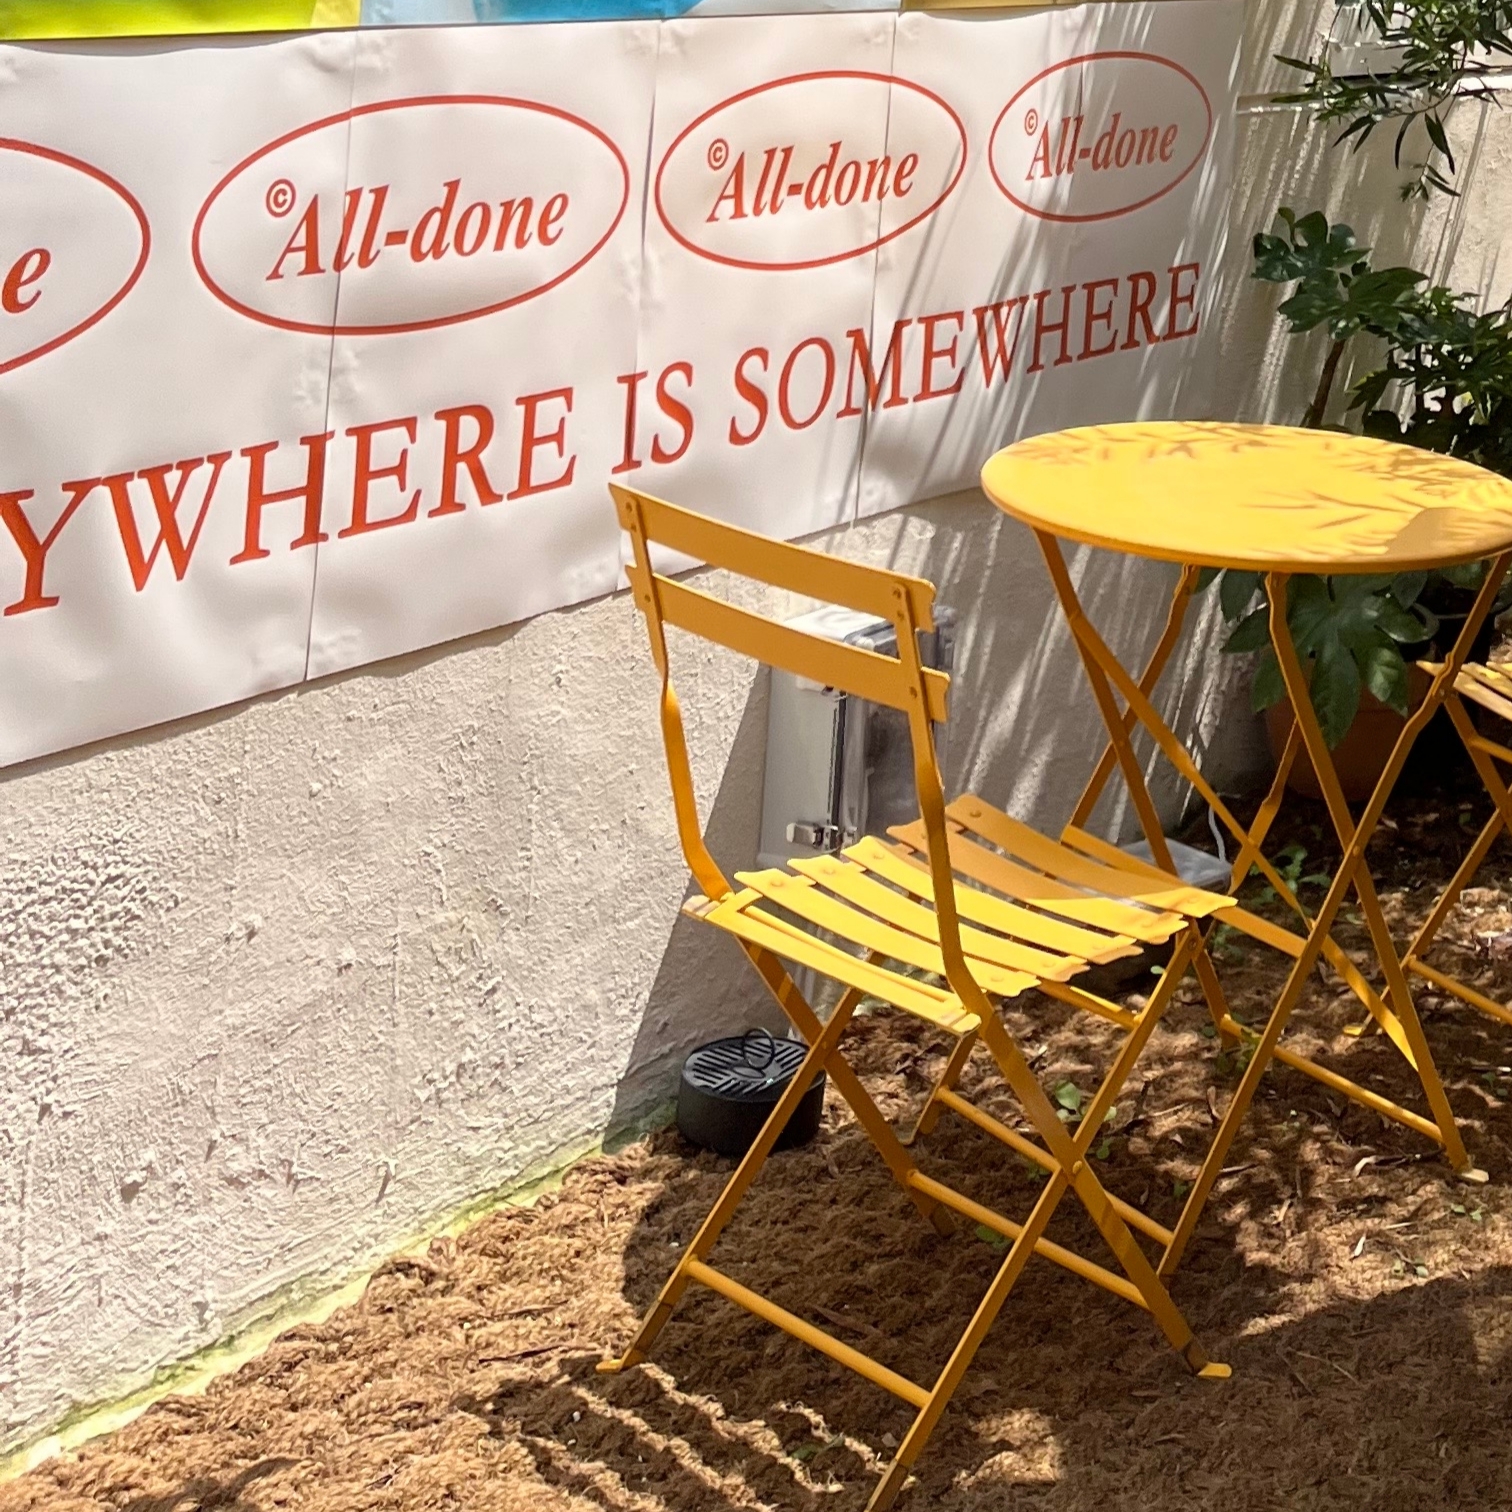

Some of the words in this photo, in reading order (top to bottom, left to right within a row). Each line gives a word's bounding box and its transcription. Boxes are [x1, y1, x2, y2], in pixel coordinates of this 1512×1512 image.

[0, 386, 578, 617] YWHERE
[610, 360, 694, 475] IS
[727, 262, 1201, 447] SOMEWHERE
